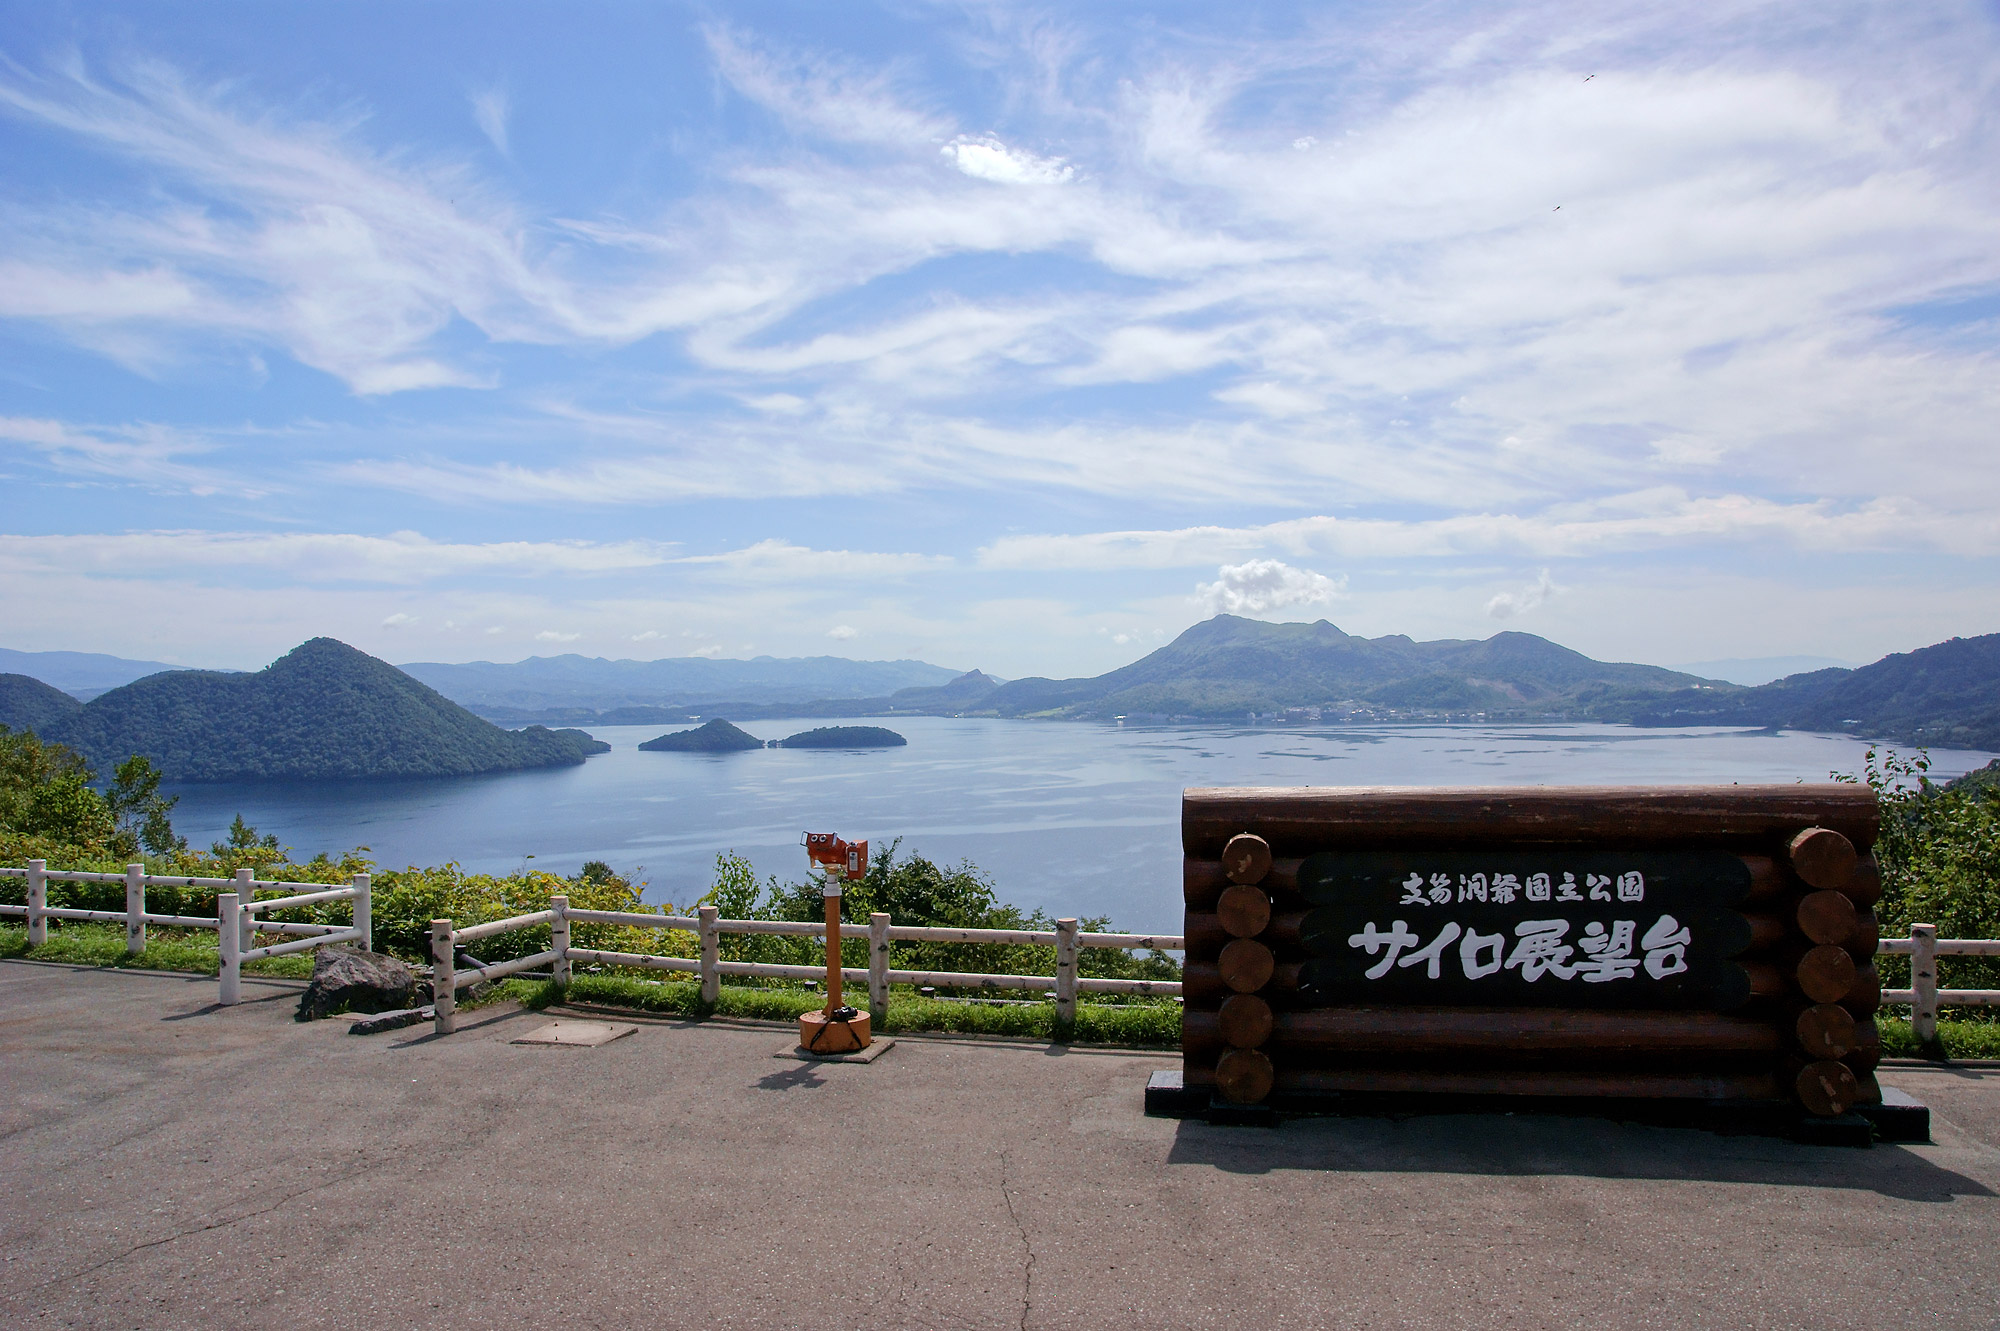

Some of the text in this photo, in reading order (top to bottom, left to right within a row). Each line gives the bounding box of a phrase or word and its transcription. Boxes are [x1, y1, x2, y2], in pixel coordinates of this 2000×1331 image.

[1347, 914, 1691, 983] サイロ展望台
